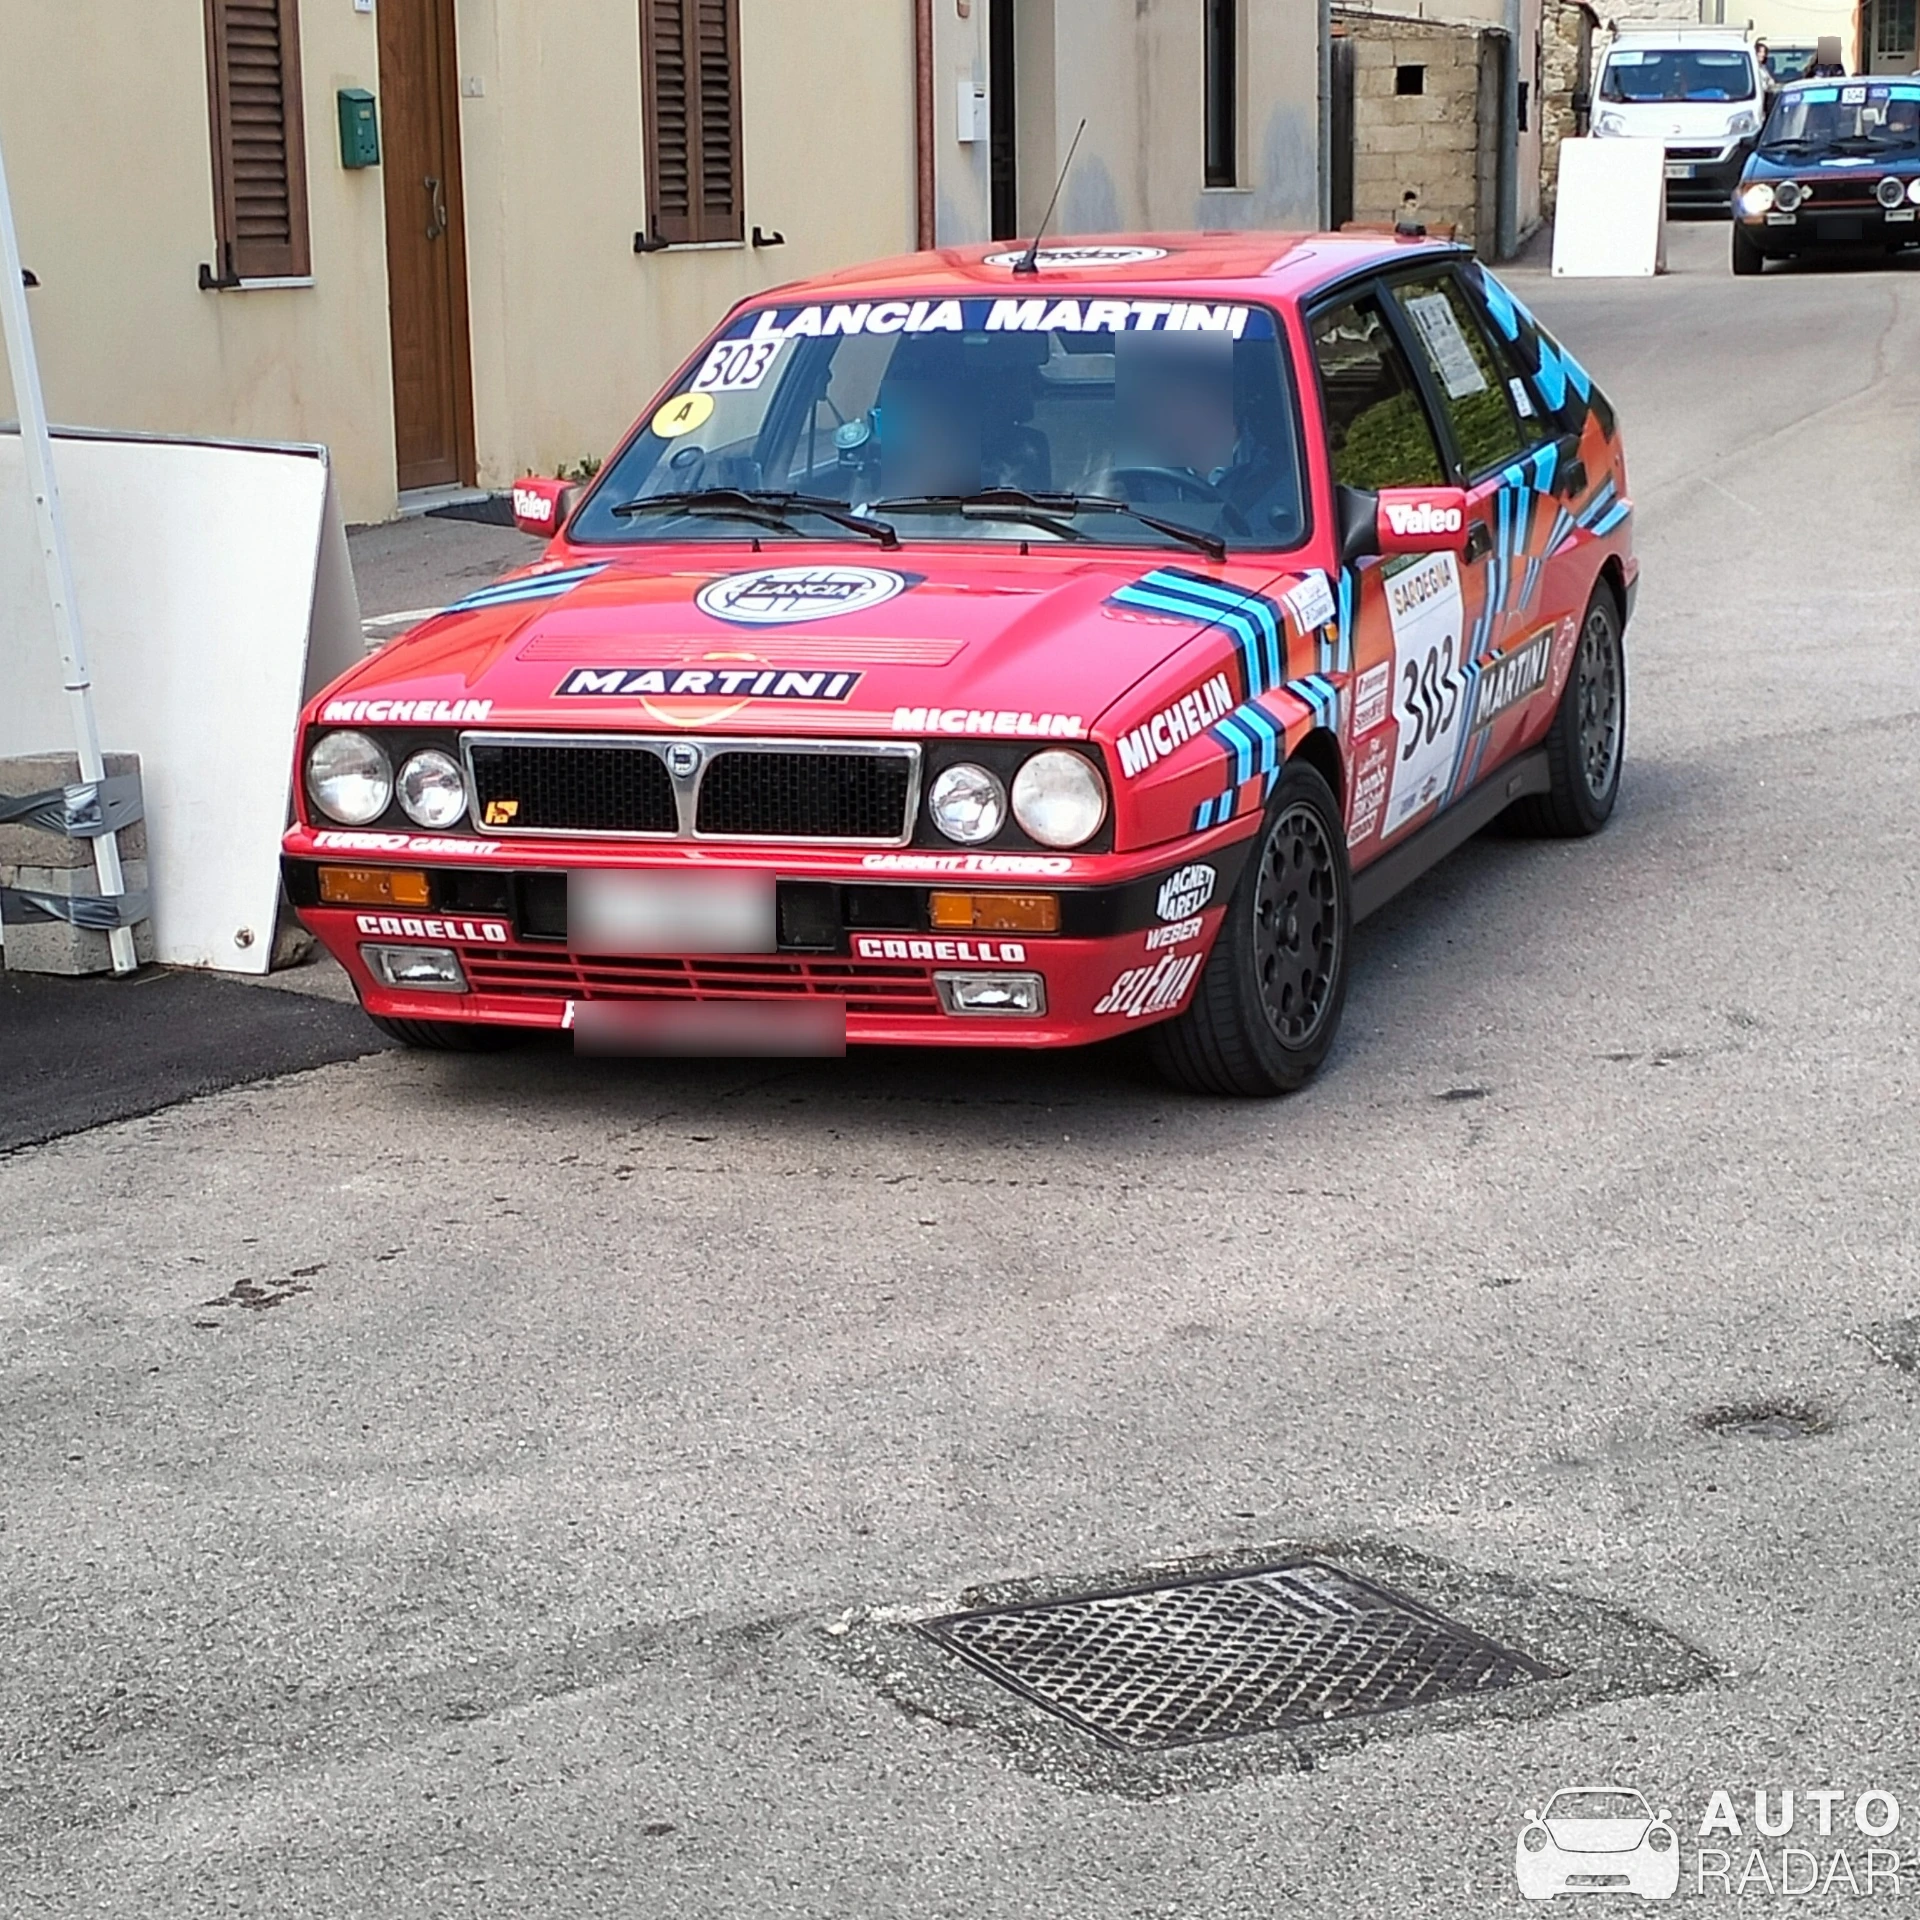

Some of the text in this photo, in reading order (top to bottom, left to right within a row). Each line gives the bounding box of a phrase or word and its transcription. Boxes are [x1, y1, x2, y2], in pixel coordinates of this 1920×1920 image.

[750, 299, 1249, 340] LANCIA MARTINI
[698, 341, 776, 389] 303
[672, 401, 694, 422] A
[513, 488, 552, 521] Valeo
[1385, 502, 1462, 535] Valeo
[748, 583, 853, 598] LANCIA
[1394, 558, 1453, 616] SARDEGNA
[567, 670, 850, 697] MARTINI
[1476, 636, 1551, 725] MARTINI
[322, 699, 494, 723] MICHELIN
[1402, 634, 1458, 762] 303
[892, 707, 1084, 737] MICHELIN
[1116, 672, 1234, 778] MICHELIN
[313, 831, 410, 849] TURBO
[964, 855, 1072, 873] TURBO
[356, 915, 507, 942] CARELLO
[1145, 916, 1203, 950] WEBER
[858, 938, 1026, 963] CARELLO
